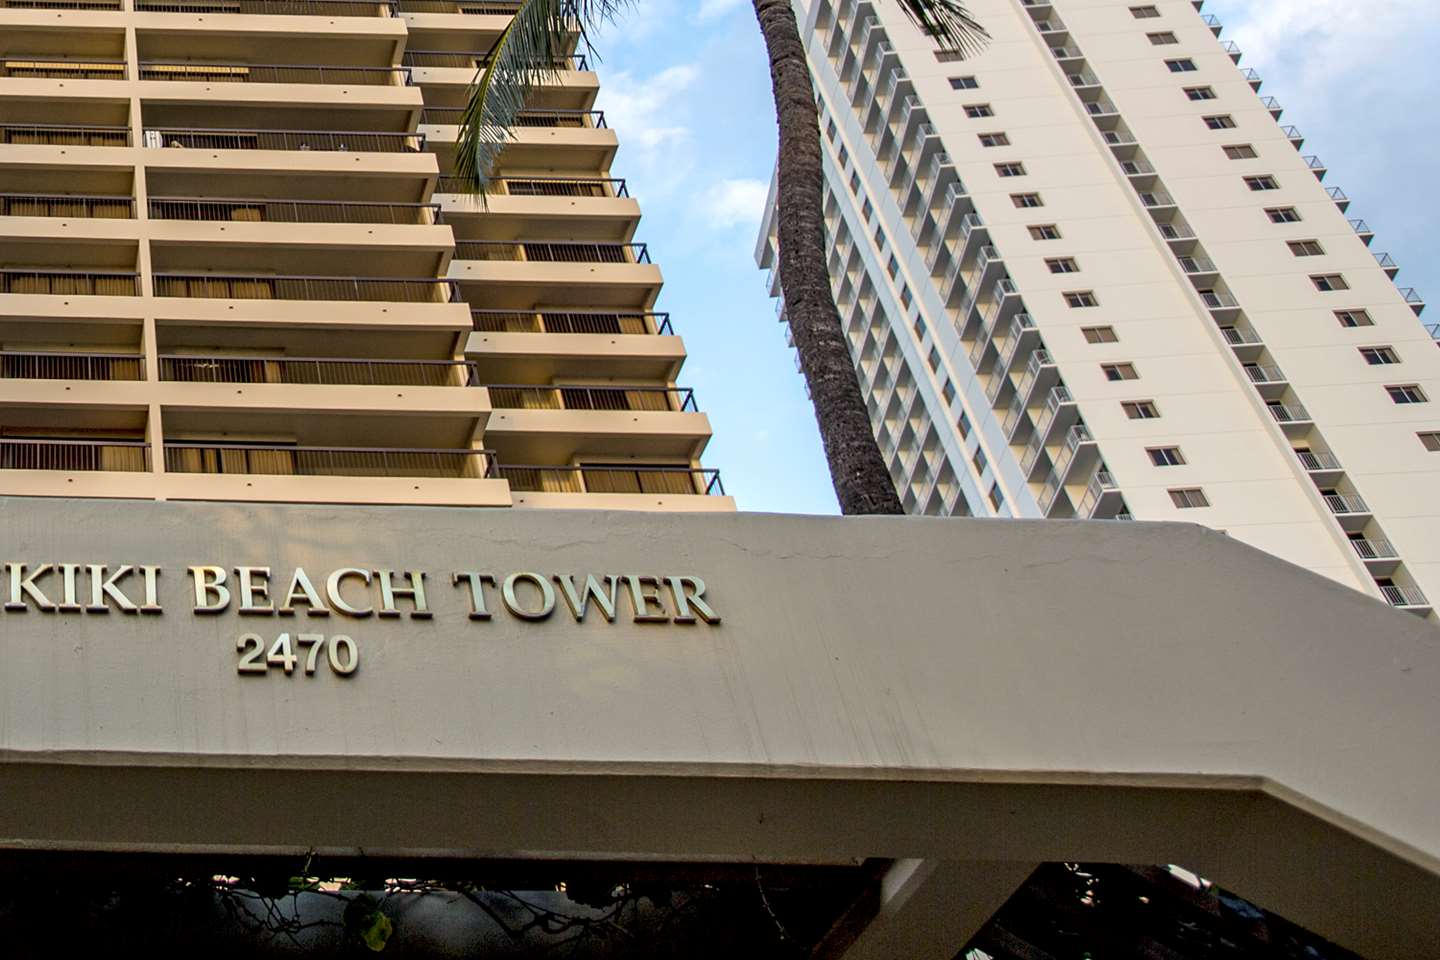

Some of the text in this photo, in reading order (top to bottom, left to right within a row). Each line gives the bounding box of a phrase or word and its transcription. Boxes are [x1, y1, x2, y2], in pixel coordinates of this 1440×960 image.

[187, 566, 433, 620] BEACH
[451, 571, 722, 625] TOWER
[236, 632, 359, 677] 2470
